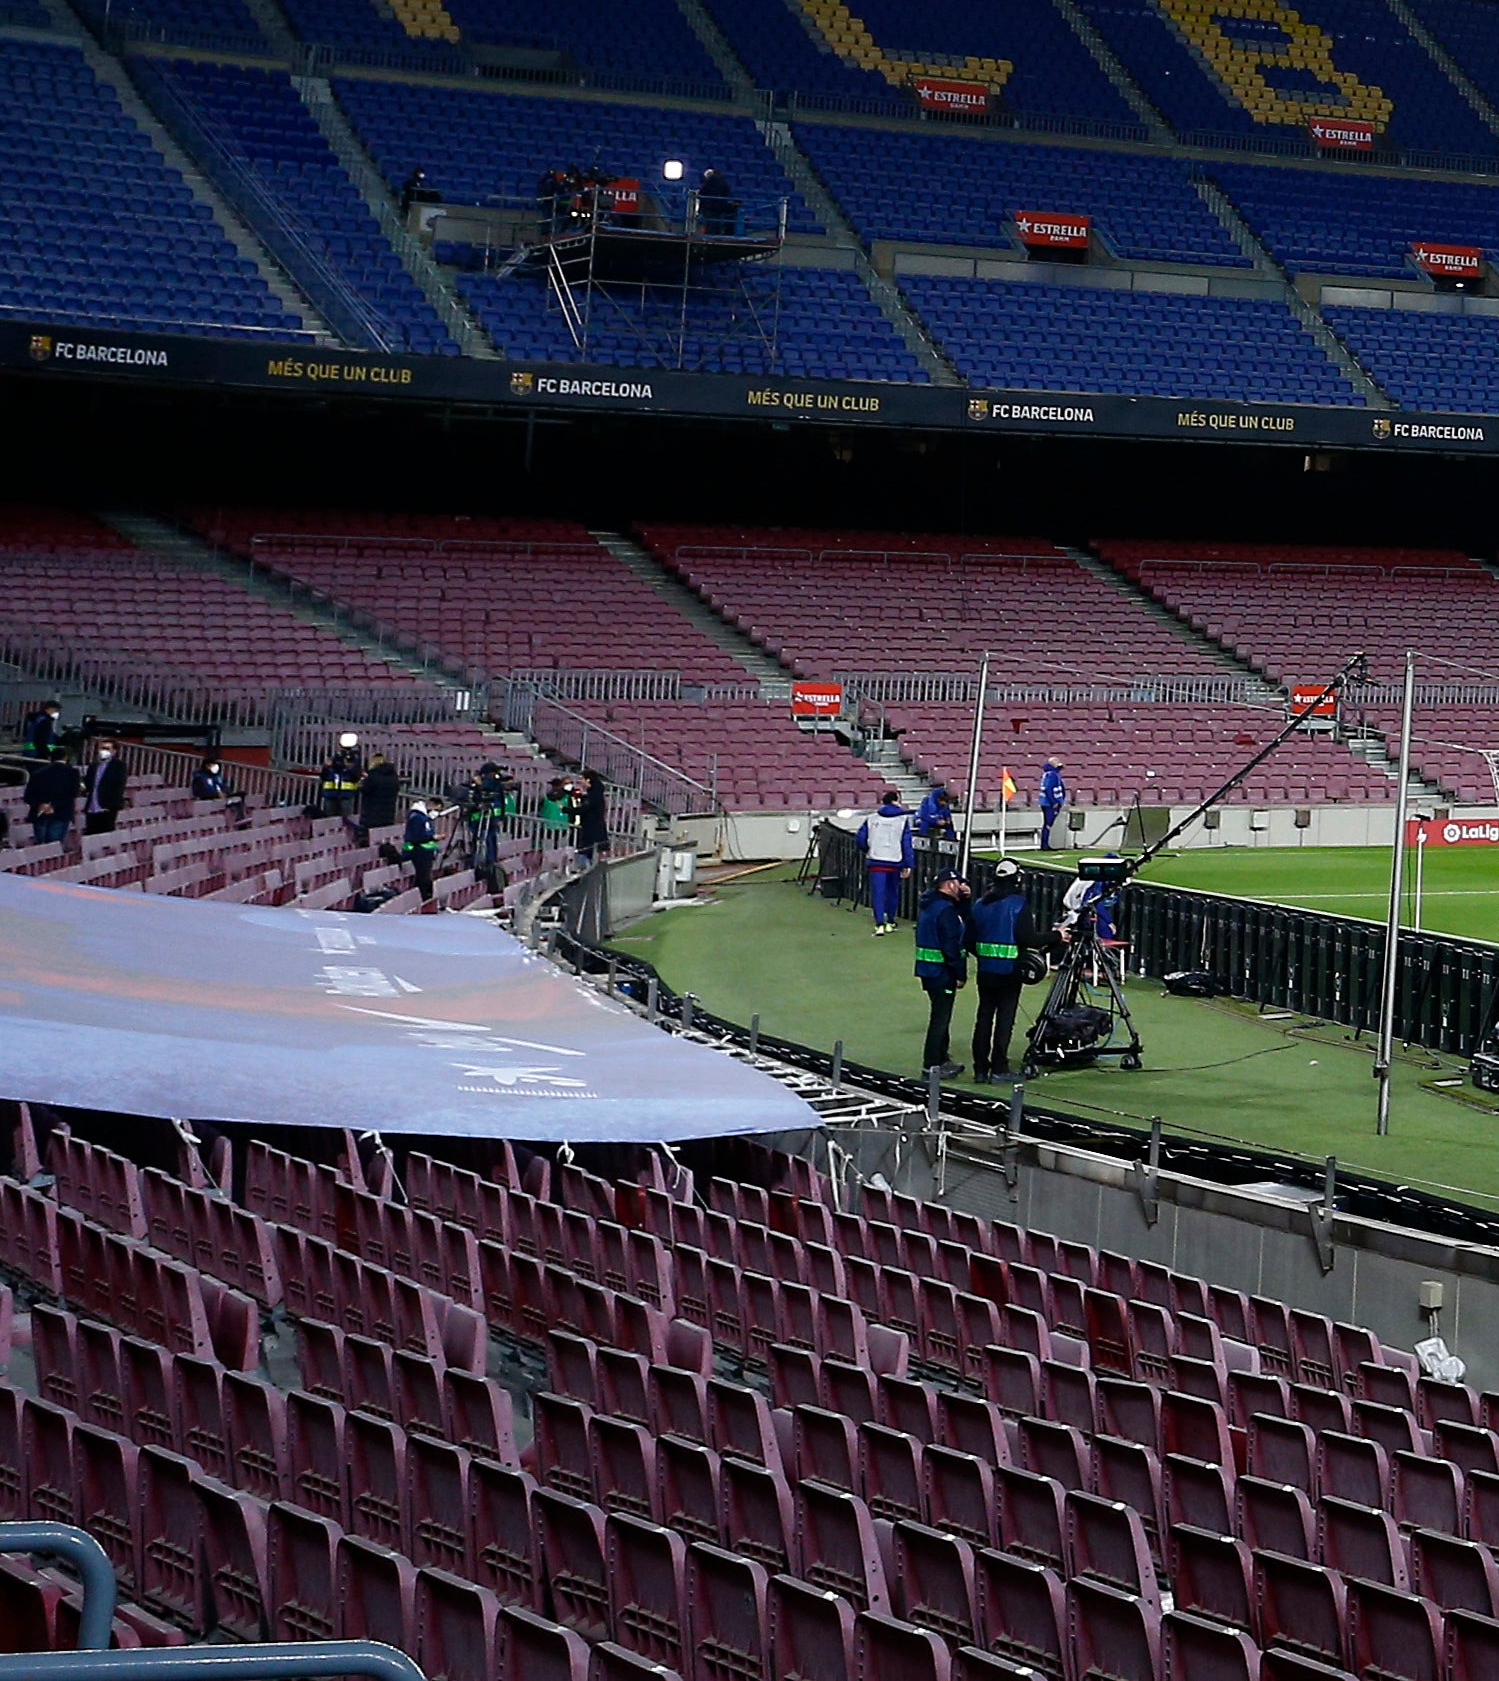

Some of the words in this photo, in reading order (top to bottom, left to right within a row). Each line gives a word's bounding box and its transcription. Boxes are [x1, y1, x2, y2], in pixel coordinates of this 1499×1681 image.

[934, 91, 985, 106] ESTRELLA
[1325, 129, 1372, 143] ESTRELLA
[1033, 224, 1087, 238] ESTRELLA
[1429, 255, 1478, 268] ESTRELLA
[55, 342, 74, 359] FC
[76, 344, 168, 367] BARCELONA
[268, 360, 302, 376] MÉS
[307, 364, 340, 381] QUE
[344, 365, 366, 381] UN
[370, 367, 412, 384] CLUB
[537, 377, 556, 393] FC
[559, 379, 652, 400] BARCELONA
[747, 390, 780, 406] MÉS
[784, 393, 815, 409] QUE
[818, 395, 839, 409] UN
[841, 396, 879, 412] CLUB
[992, 404, 1009, 417] FC
[1012, 405, 1093, 422] BARCELONA
[1178, 412, 1207, 427] MÉS
[1209, 415, 1236, 430] QUE
[1239, 416, 1258, 429] UN
[1261, 417, 1295, 431] CLUB
[1394, 423, 1409, 436] FC
[1411, 424, 1484, 441] BARCELONA
